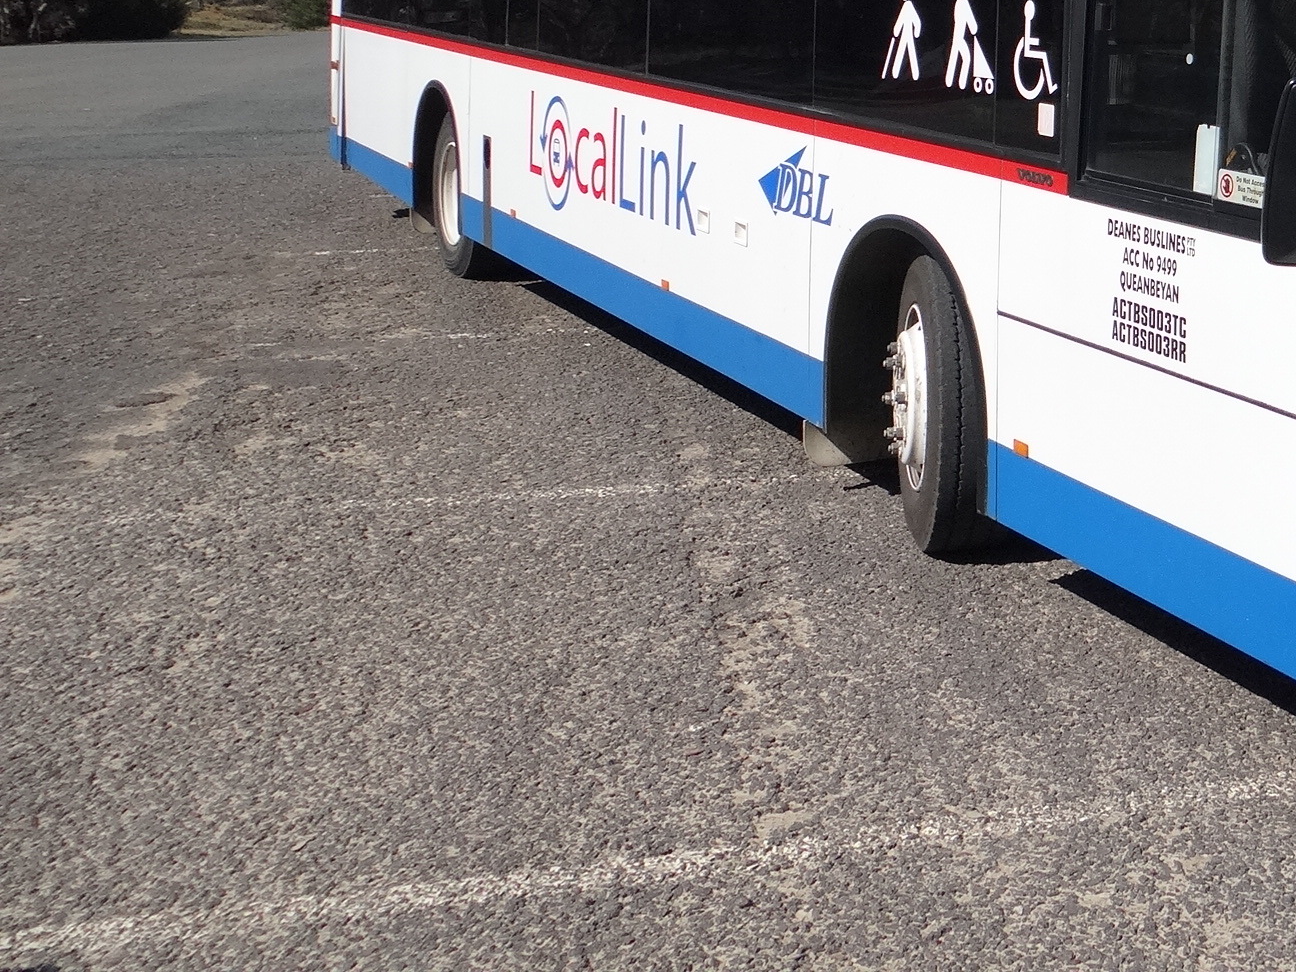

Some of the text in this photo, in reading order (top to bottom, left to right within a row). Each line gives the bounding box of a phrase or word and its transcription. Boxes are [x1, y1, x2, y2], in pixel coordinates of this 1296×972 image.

[774, 162, 834, 226] DBL
[1107, 218, 1196, 254] DEANES BUSLINES PTY
[1186, 248, 1195, 257] LTD
[1122, 247, 1178, 277] ACC No 9499
[1120, 270, 1179, 304] QUEANBEYAN
[1112, 296, 1187, 339] ACTBS003TC
[1112, 319, 1186, 363] ACTBS003RR
